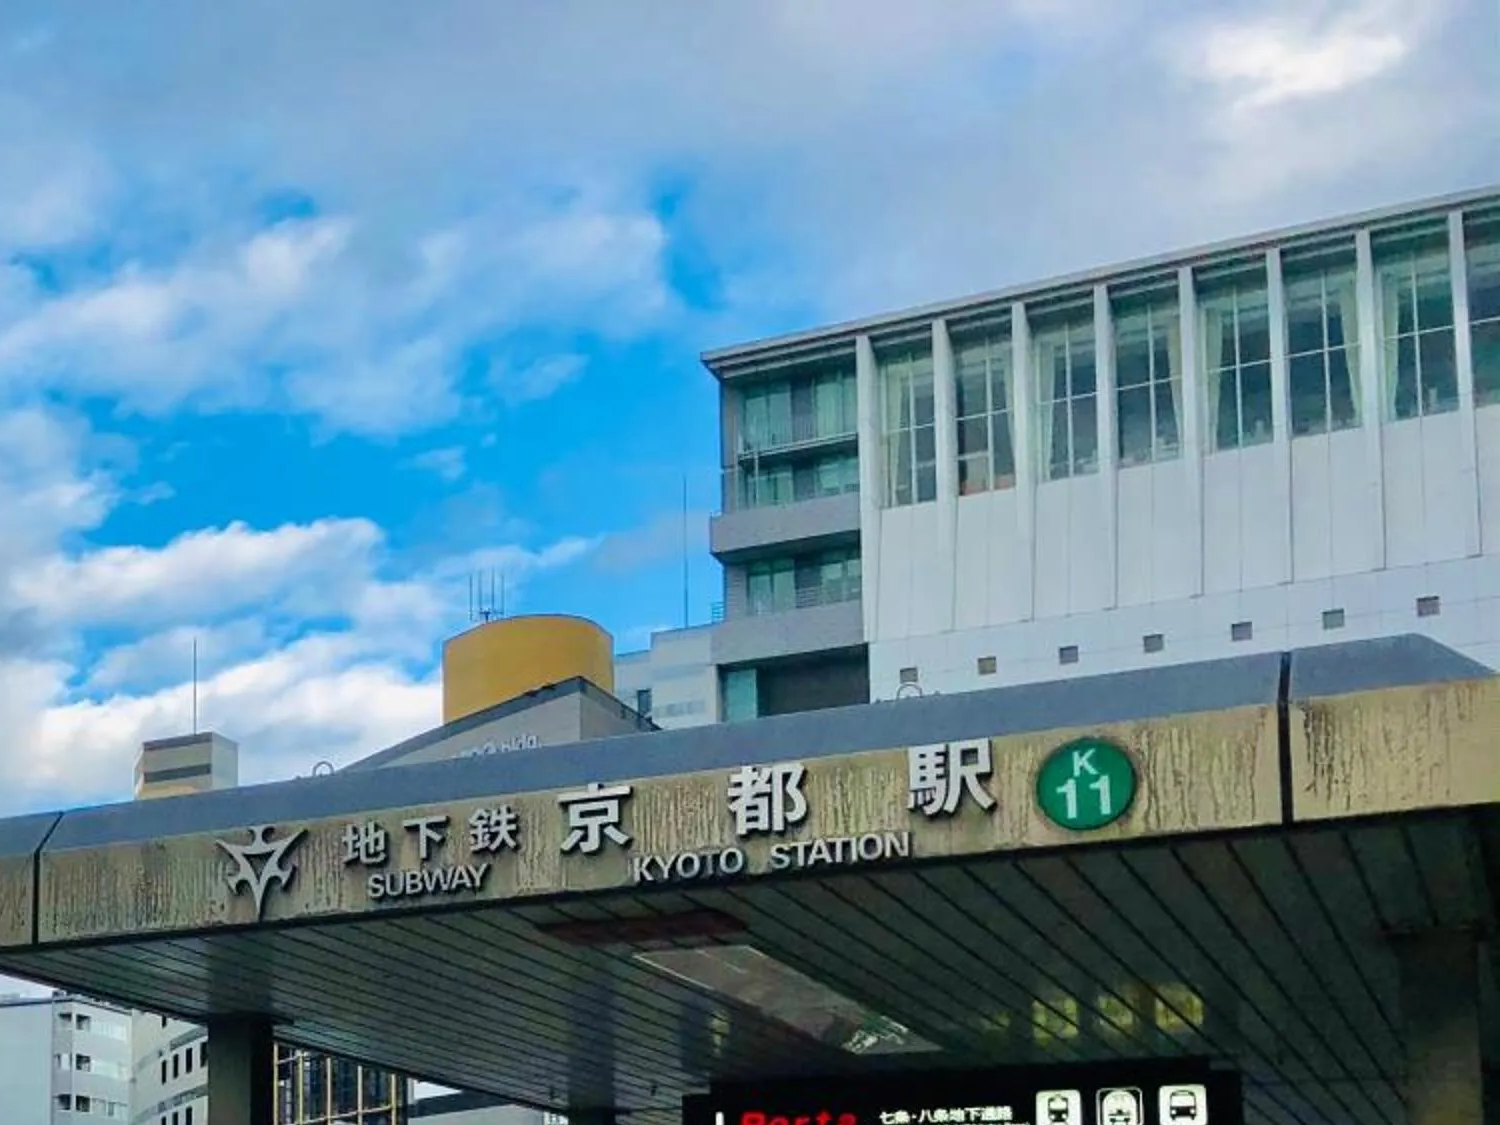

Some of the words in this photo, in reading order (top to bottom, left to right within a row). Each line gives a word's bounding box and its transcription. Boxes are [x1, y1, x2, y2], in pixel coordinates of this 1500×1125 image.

[1072, 748, 1099, 776] K
[342, 804, 518, 865] 地下鉄
[557, 738, 996, 853] 京都駅
[1056, 774, 1111, 819] 11
[367, 863, 488, 897] SUBWAY
[633, 847, 744, 883] KYOTO
[770, 831, 910, 869] STATION
